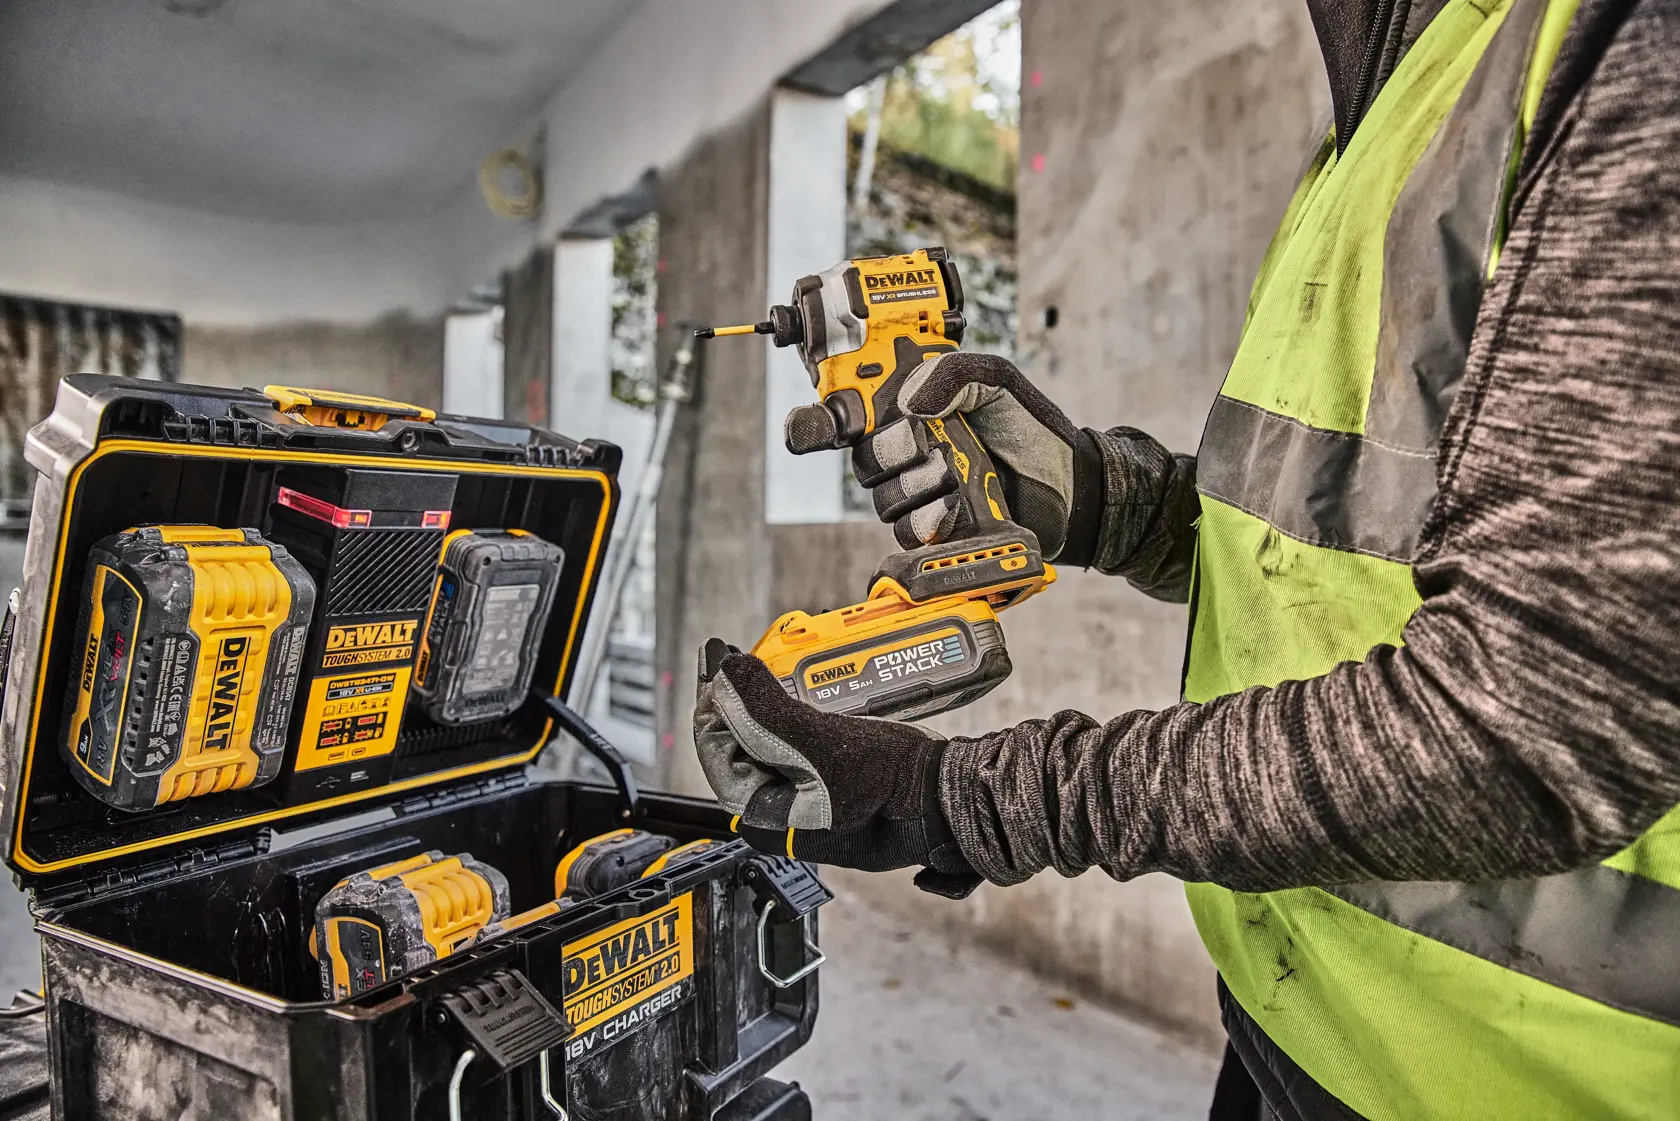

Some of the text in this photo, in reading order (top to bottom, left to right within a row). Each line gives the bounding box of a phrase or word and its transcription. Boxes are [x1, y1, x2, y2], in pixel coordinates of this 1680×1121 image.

[897, 289, 937, 298] BRUSHLESS
[325, 622, 418, 650] DEWALT
[395, 648, 411, 659] 2.0
[873, 640, 944, 670] POWER
[878, 654, 944, 682] STACK
[204, 636, 248, 752] DEWALT
[815, 685, 841, 700] 18V
[360, 928, 374, 960] 54V
[563, 910, 680, 997] DEWALT
[660, 959, 679, 978] 2.0
[565, 984, 682, 1062] 18V CHARGER
